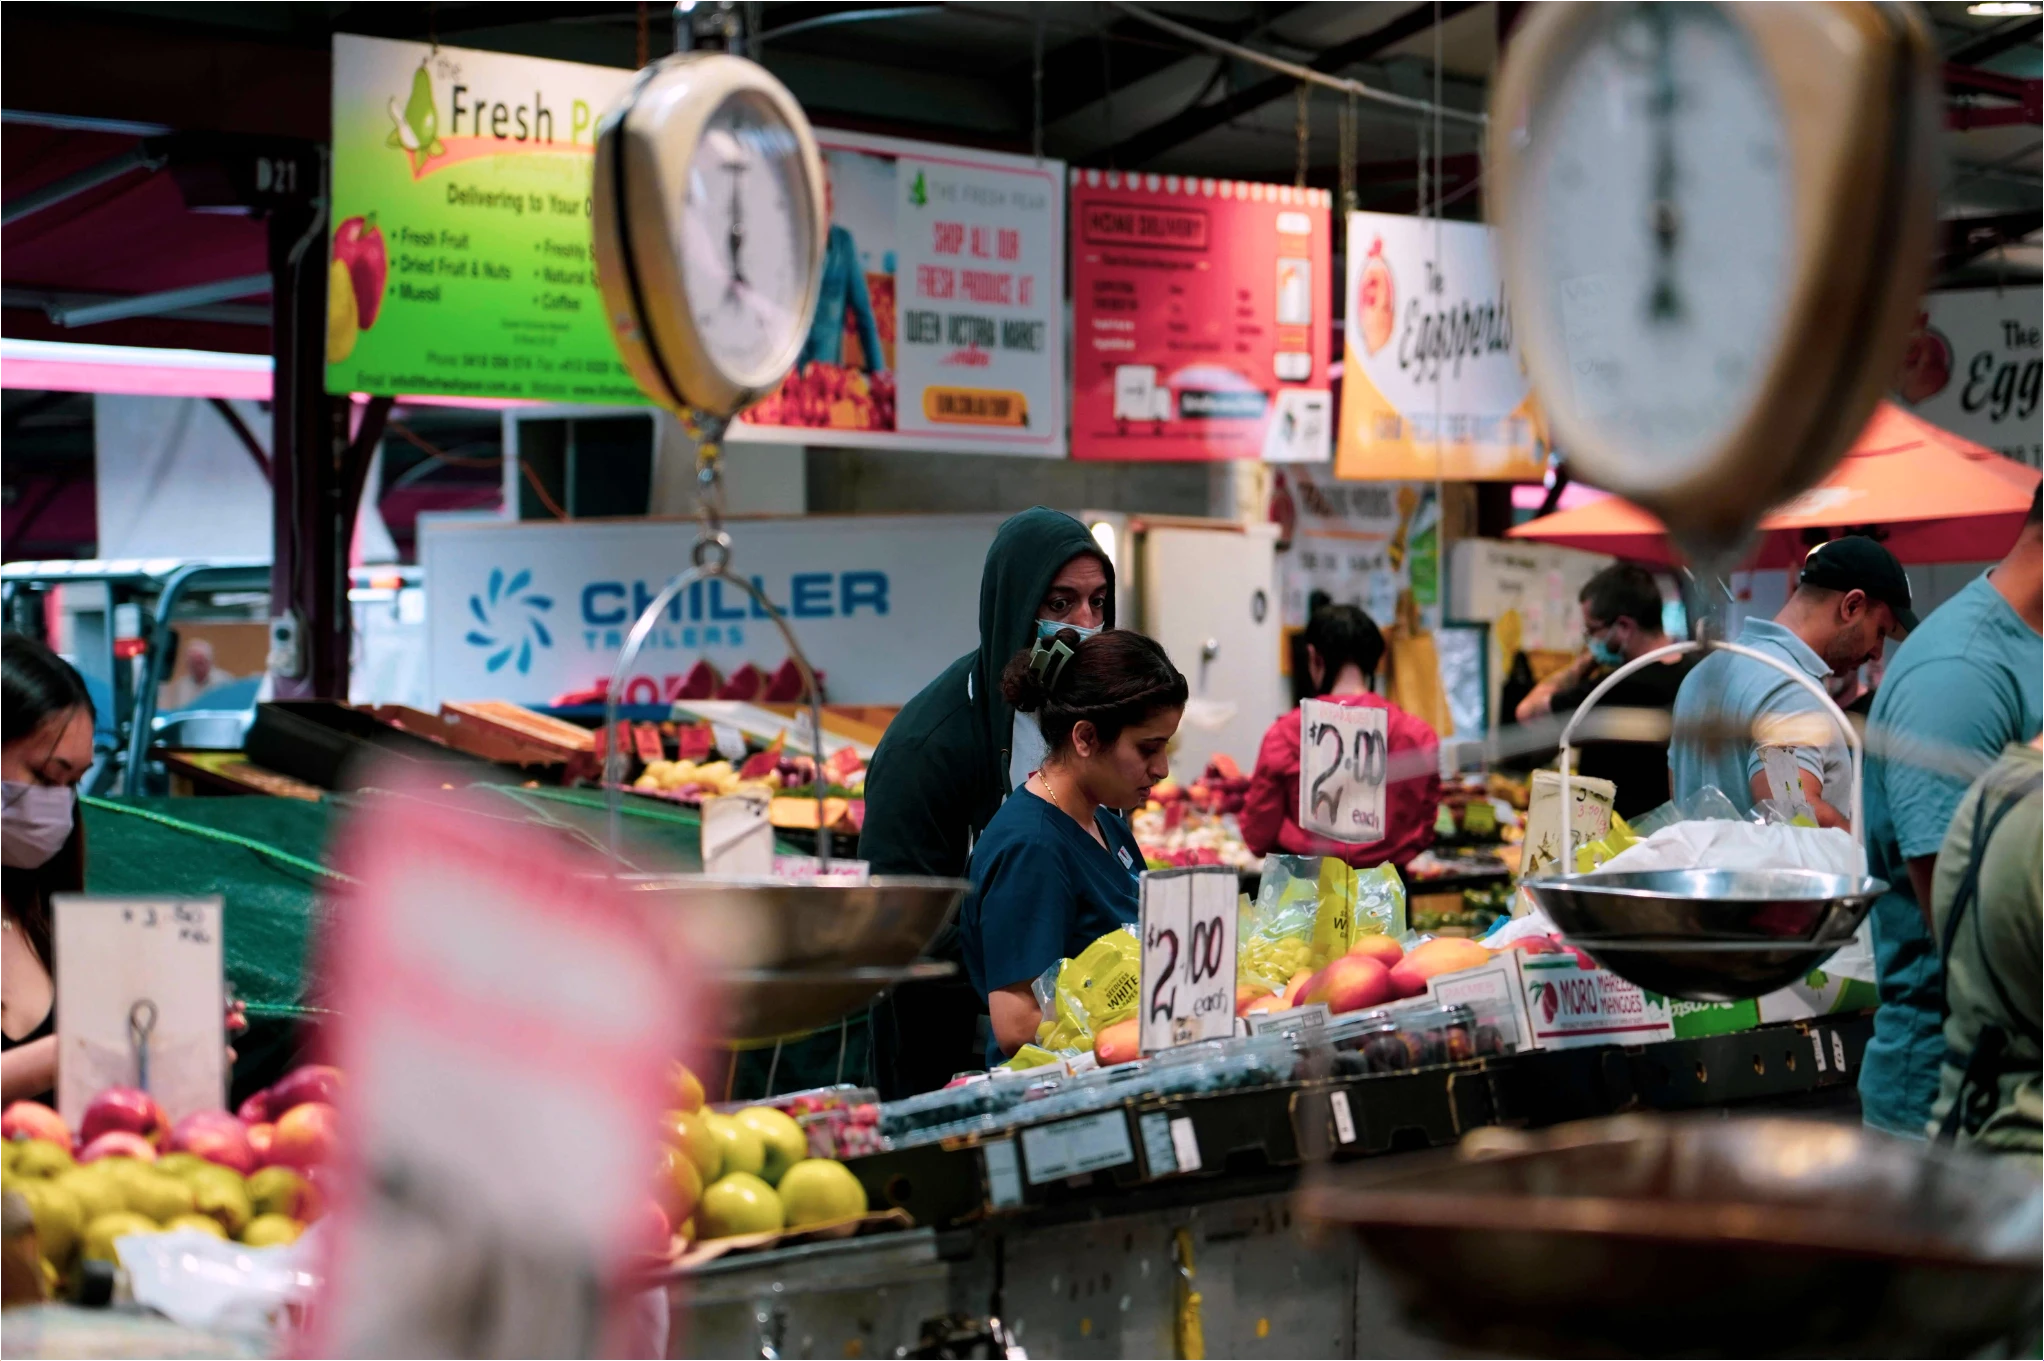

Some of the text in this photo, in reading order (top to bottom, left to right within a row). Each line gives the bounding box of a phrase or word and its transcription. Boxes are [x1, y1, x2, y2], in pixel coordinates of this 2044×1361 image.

[452, 84, 553, 145] Fresh
[256, 157, 297, 193] D21
[448, 183, 523, 214] Delivering
[529, 193, 543, 213] to
[549, 194, 580, 216] Your
[401, 227, 469, 251] Fresh Fruit
[1091, 212, 1134, 236] HOME
[934, 220, 964, 255] SHOP
[997, 228, 1019, 261] OUR
[401, 254, 511, 281] Dried Fruit & Nuts
[544, 267, 585, 285] Natural
[917, 264, 955, 299] FRESH
[1425, 261, 1443, 294] The
[400, 283, 441, 303] Muesli
[543, 292, 580, 312] Coffee
[2001, 320, 2040, 349] The
[580, 569, 889, 627] CHILLER
[1352, 808, 1381, 830] each
[1105, 971, 1131, 1000] SEEDLESS
[1146, 915, 1225, 1025] $2.00
[1106, 973, 1139, 1011] WHITE
[1193, 986, 1228, 1018] each
[1558, 978, 1598, 1015] MORO
[1599, 994, 1643, 1016] MANGOES
